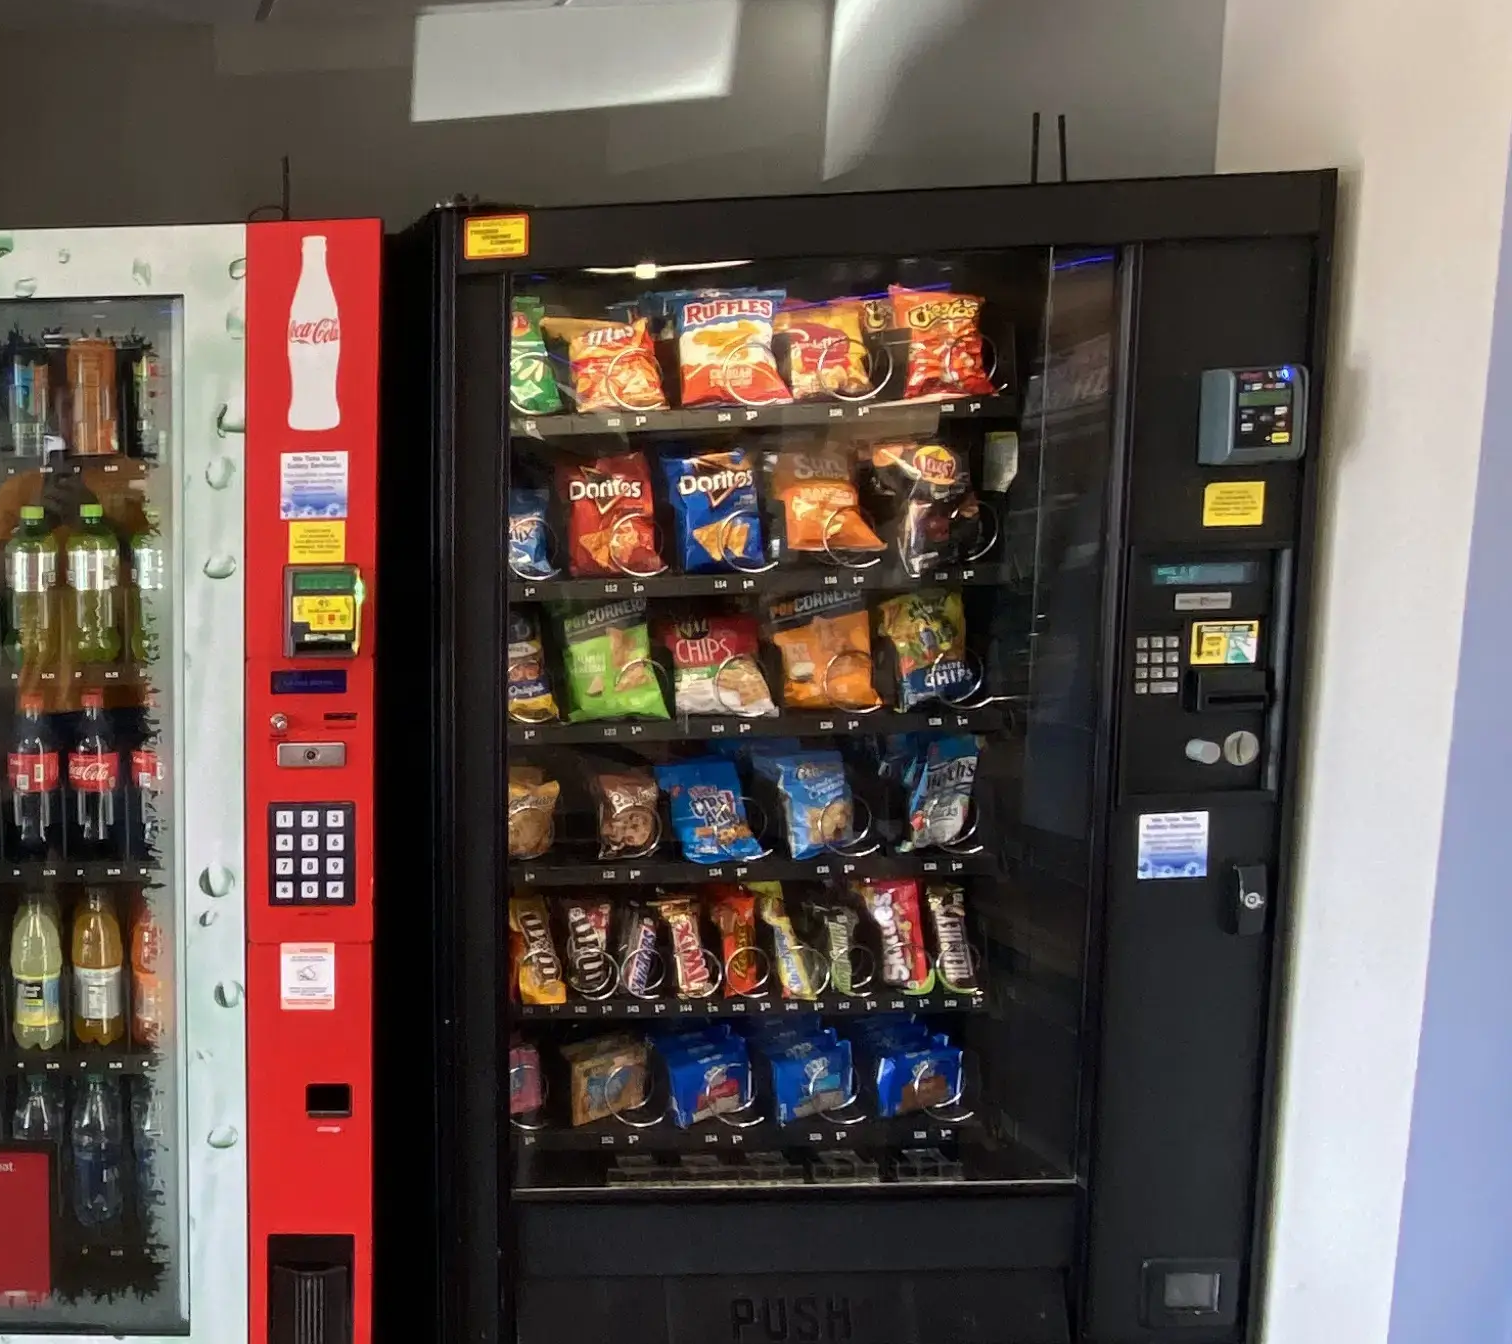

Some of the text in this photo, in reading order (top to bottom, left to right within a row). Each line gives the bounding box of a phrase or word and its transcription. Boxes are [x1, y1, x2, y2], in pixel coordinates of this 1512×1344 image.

[684, 298, 773, 326] RUFFLES
[569, 476, 641, 501] Doritos
[678, 469, 753, 496] Doritos
[675, 638, 733, 664] CHIPS
[731, 1295, 852, 1341] PUSH
